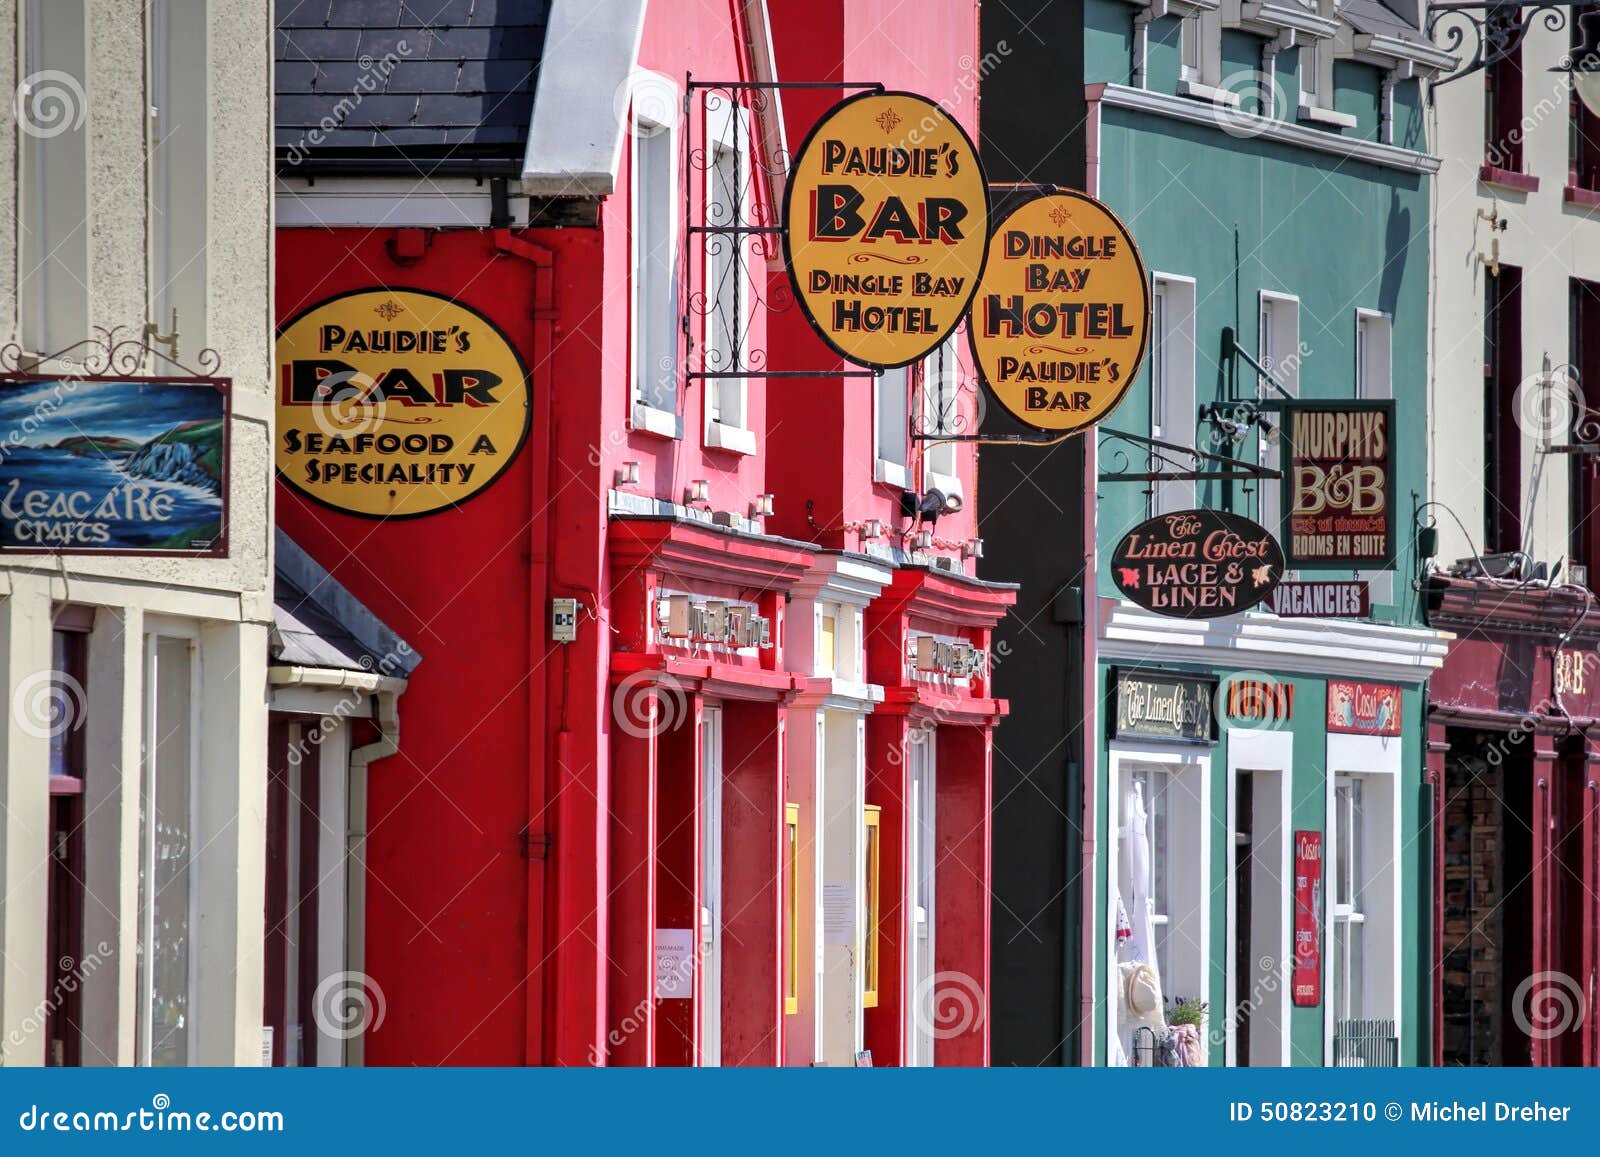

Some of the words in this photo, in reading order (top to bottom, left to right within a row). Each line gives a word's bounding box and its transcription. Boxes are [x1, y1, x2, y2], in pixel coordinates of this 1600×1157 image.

[821, 139, 960, 178] PAUDIE'S
[809, 184, 969, 245] BAR
[1004, 230, 1116, 260] DINGLE
[809, 269, 903, 294] DINGLE
[911, 272, 965, 297] BAY
[1024, 264, 1090, 292] BAY
[832, 301, 938, 334] HOTEL
[983, 294, 1134, 339] HOTEL
[320, 325, 472, 354] PAUDIE'S
[282, 359, 503, 408] BAR
[997, 356, 1120, 383] PAUDIE'S
[1025, 387, 1091, 412] BAR
[283, 428, 454, 455] SEAFOOD
[468, 434, 497, 455] A
[1293, 412, 1385, 458] MURPHYS
[304, 458, 476, 485] SPECIALITY
[1293, 464, 1386, 516] B&B
[1165, 514, 1202, 539] The
[1125, 534, 1196, 558] Linen
[1202, 529, 1270, 562] Chest
[1293, 535, 1334, 556] ROOMS
[1337, 535, 1350, 556] EN
[1353, 535, 1385, 556] SUITE
[1147, 563, 1218, 586] LACE
[1224, 562, 1244, 584] &
[1151, 586, 1237, 608] LINEN
[1272, 584, 1361, 615] VACANCIES
